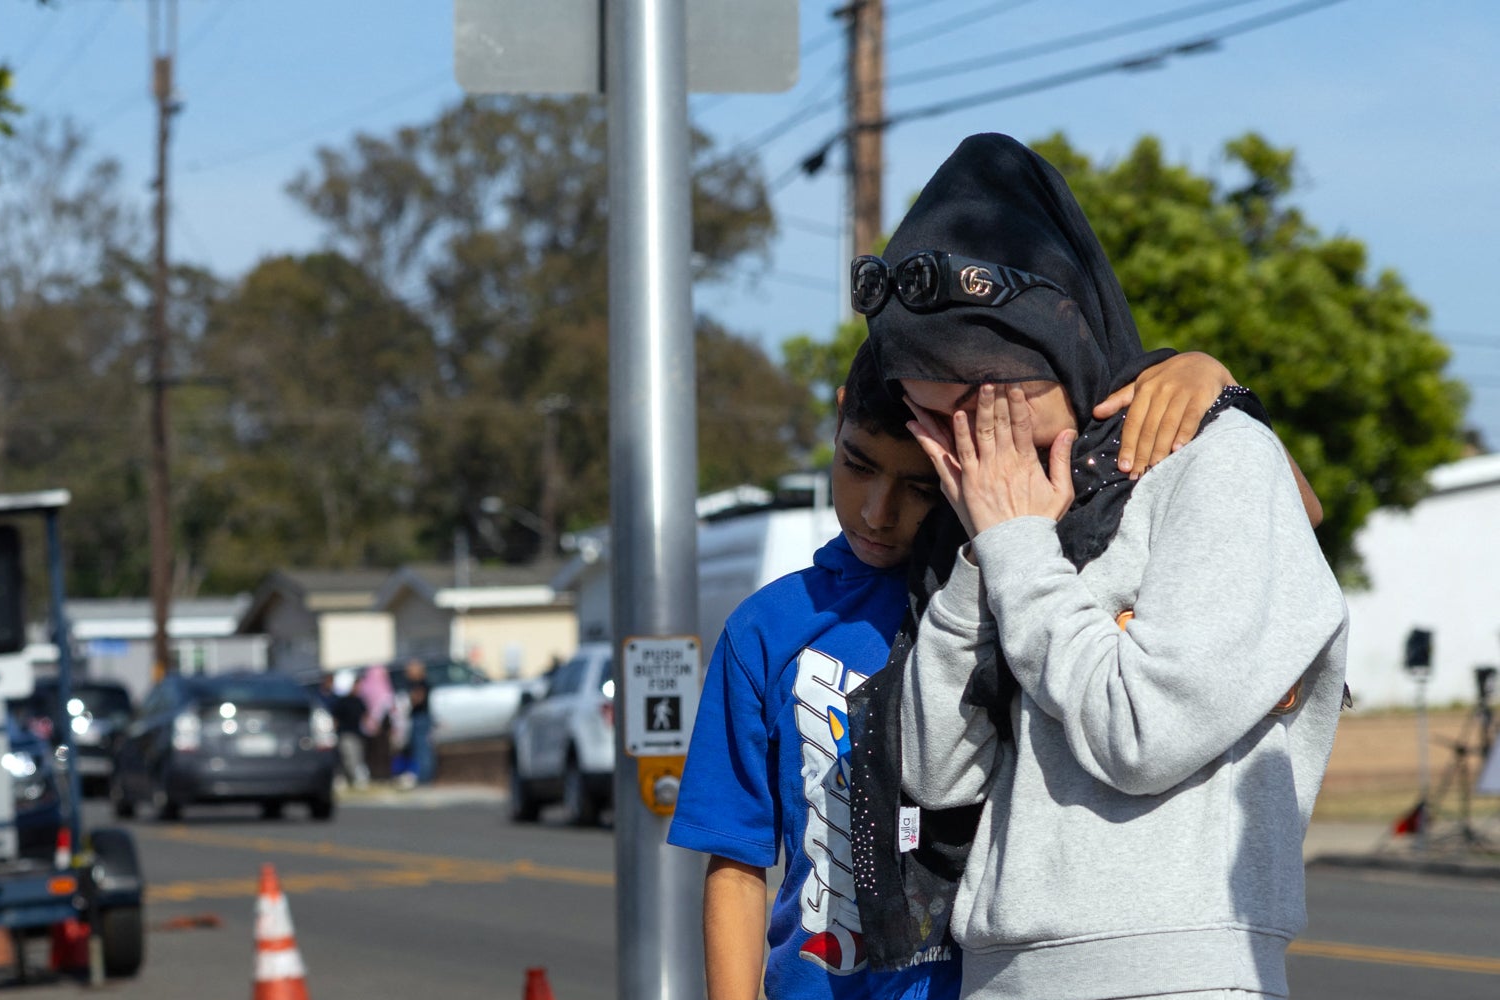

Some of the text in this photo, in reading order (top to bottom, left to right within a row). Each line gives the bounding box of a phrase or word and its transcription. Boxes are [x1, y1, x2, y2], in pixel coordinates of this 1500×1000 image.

[642, 649, 683, 661] PUSH
[634, 664, 692, 677] BUTTON
[649, 679, 677, 690] FOR
